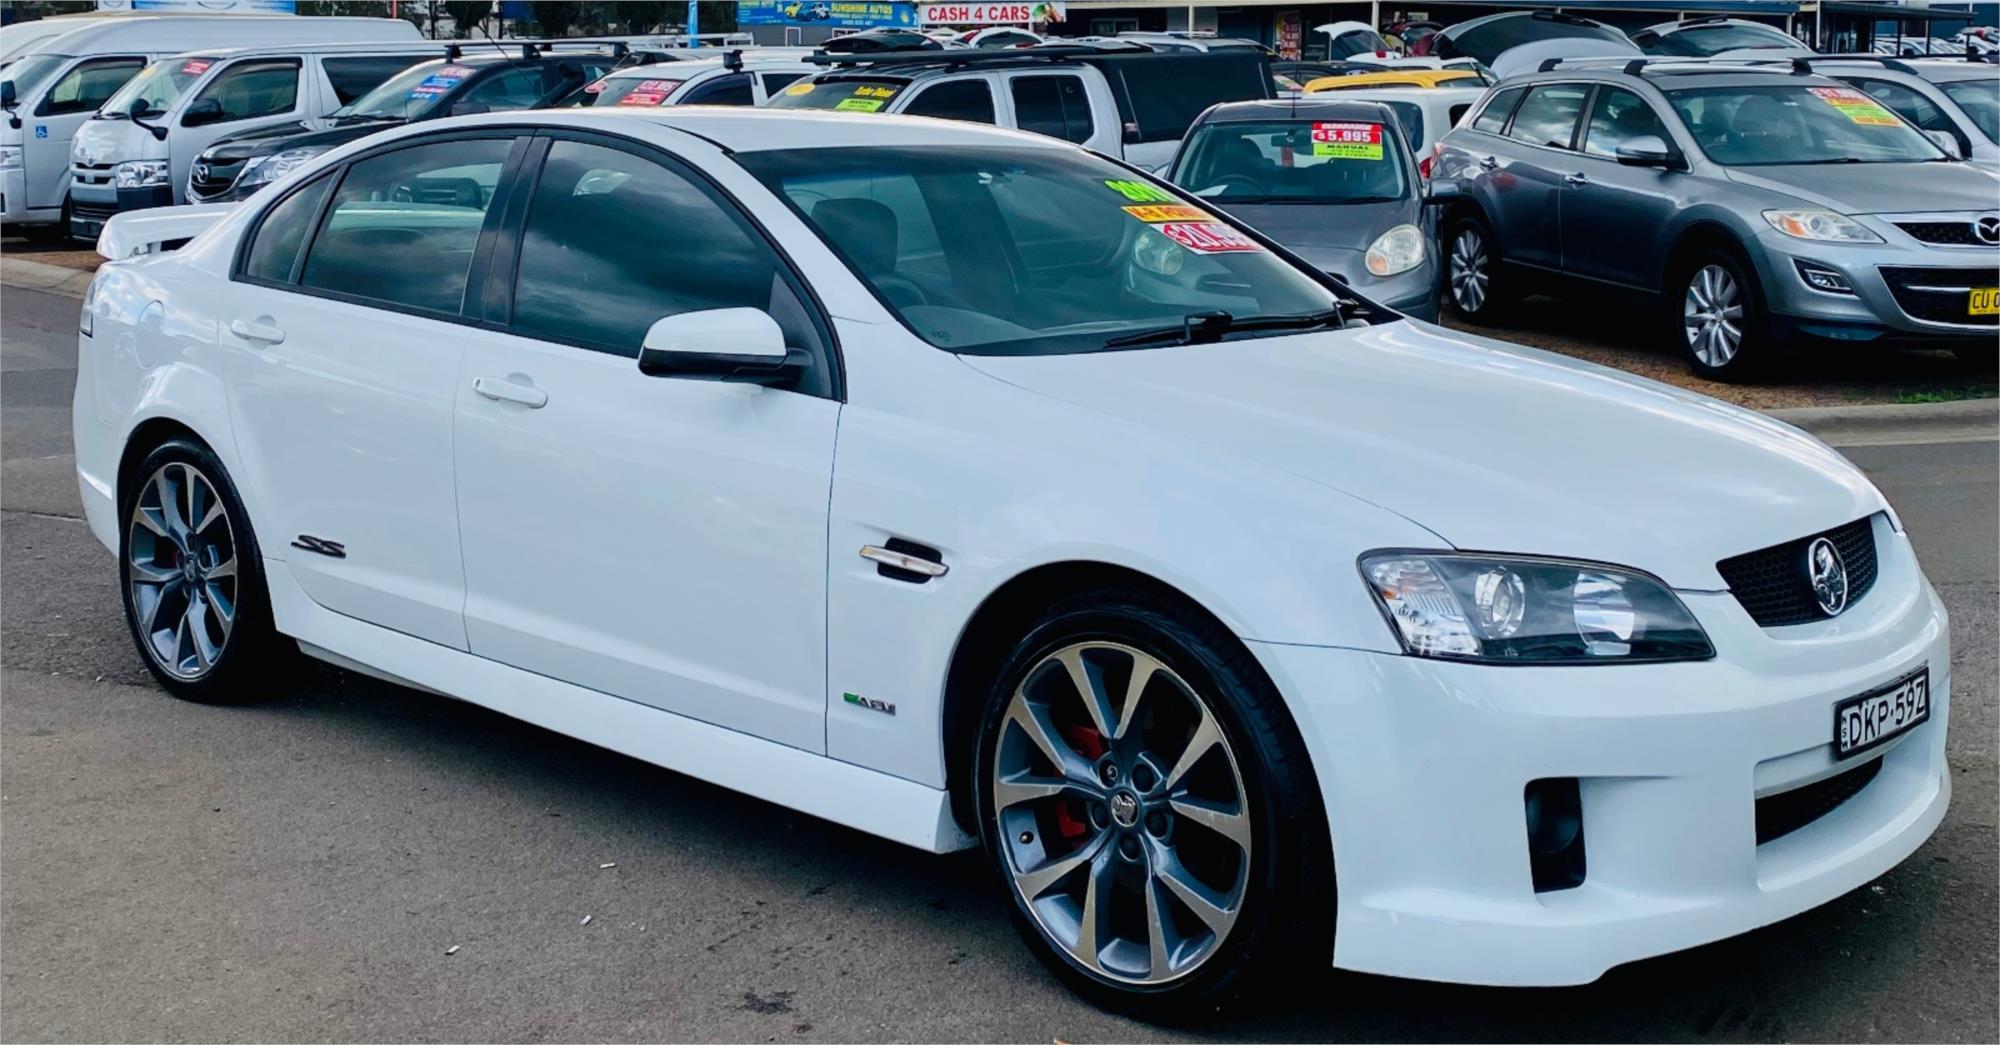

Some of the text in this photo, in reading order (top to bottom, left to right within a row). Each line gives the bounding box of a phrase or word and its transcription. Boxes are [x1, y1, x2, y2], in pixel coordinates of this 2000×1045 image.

[832, 3, 893, 15] SUNSHINE AUTOS
[928, 7, 969, 21] CASH
[974, 7, 983, 20] 4
[988, 6, 1030, 20] CARS
[1973, 293, 1990, 308] CU
[290, 535, 347, 559] SS
